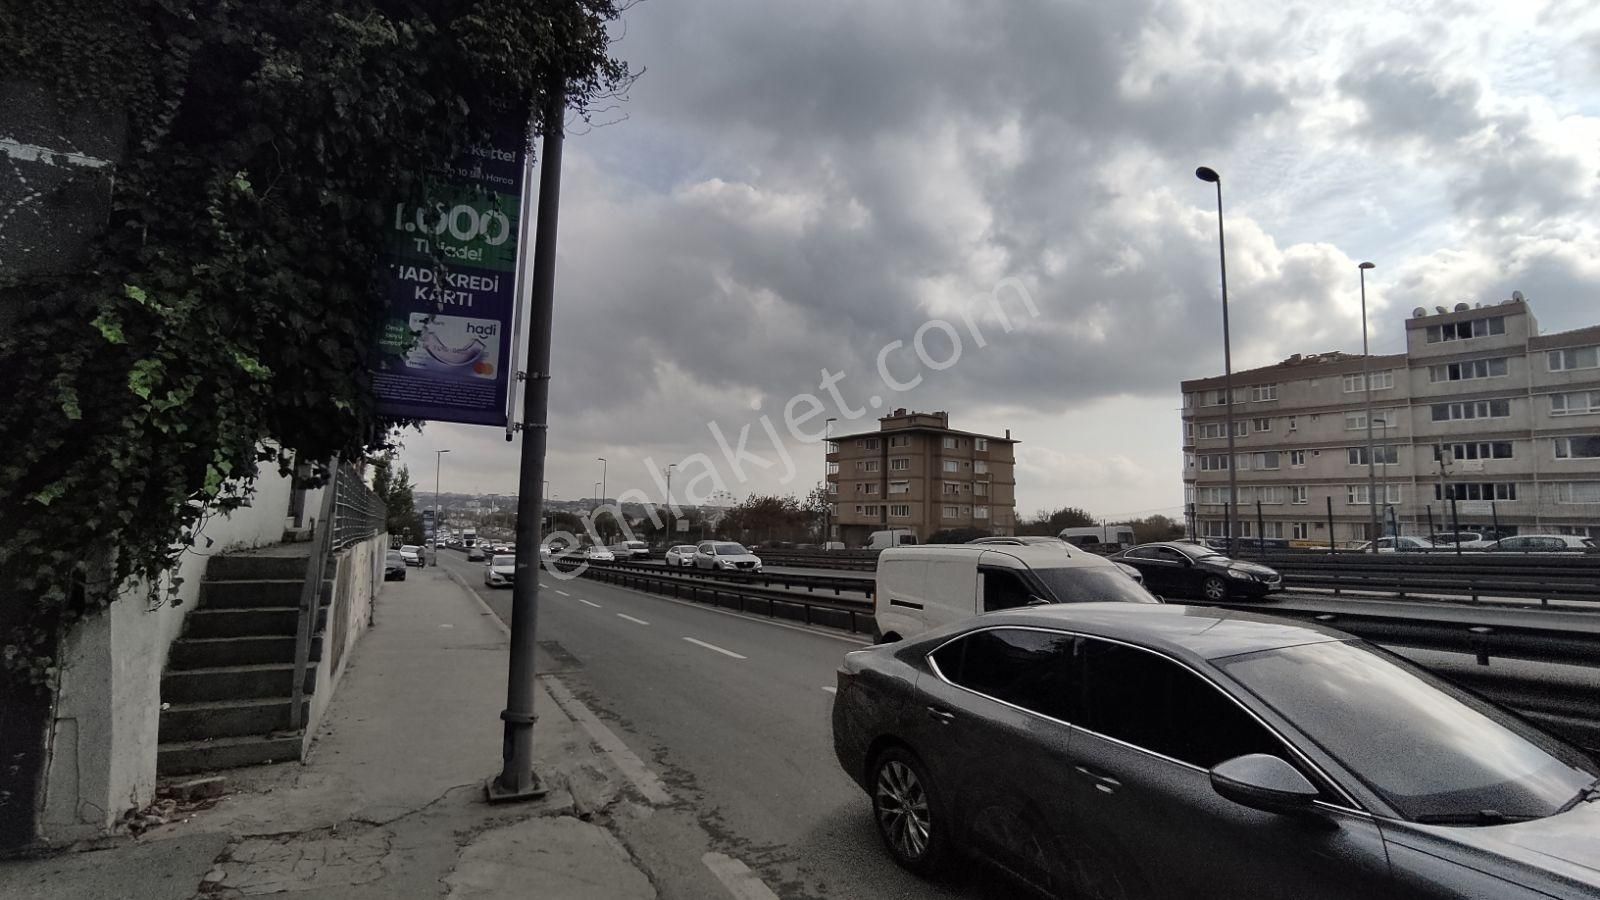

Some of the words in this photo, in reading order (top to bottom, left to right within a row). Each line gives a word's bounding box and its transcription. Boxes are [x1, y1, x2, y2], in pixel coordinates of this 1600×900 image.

[446, 271, 499, 293] KREDİ
[415, 286, 473, 307] KARTI
[466, 322, 497, 336] hadi
